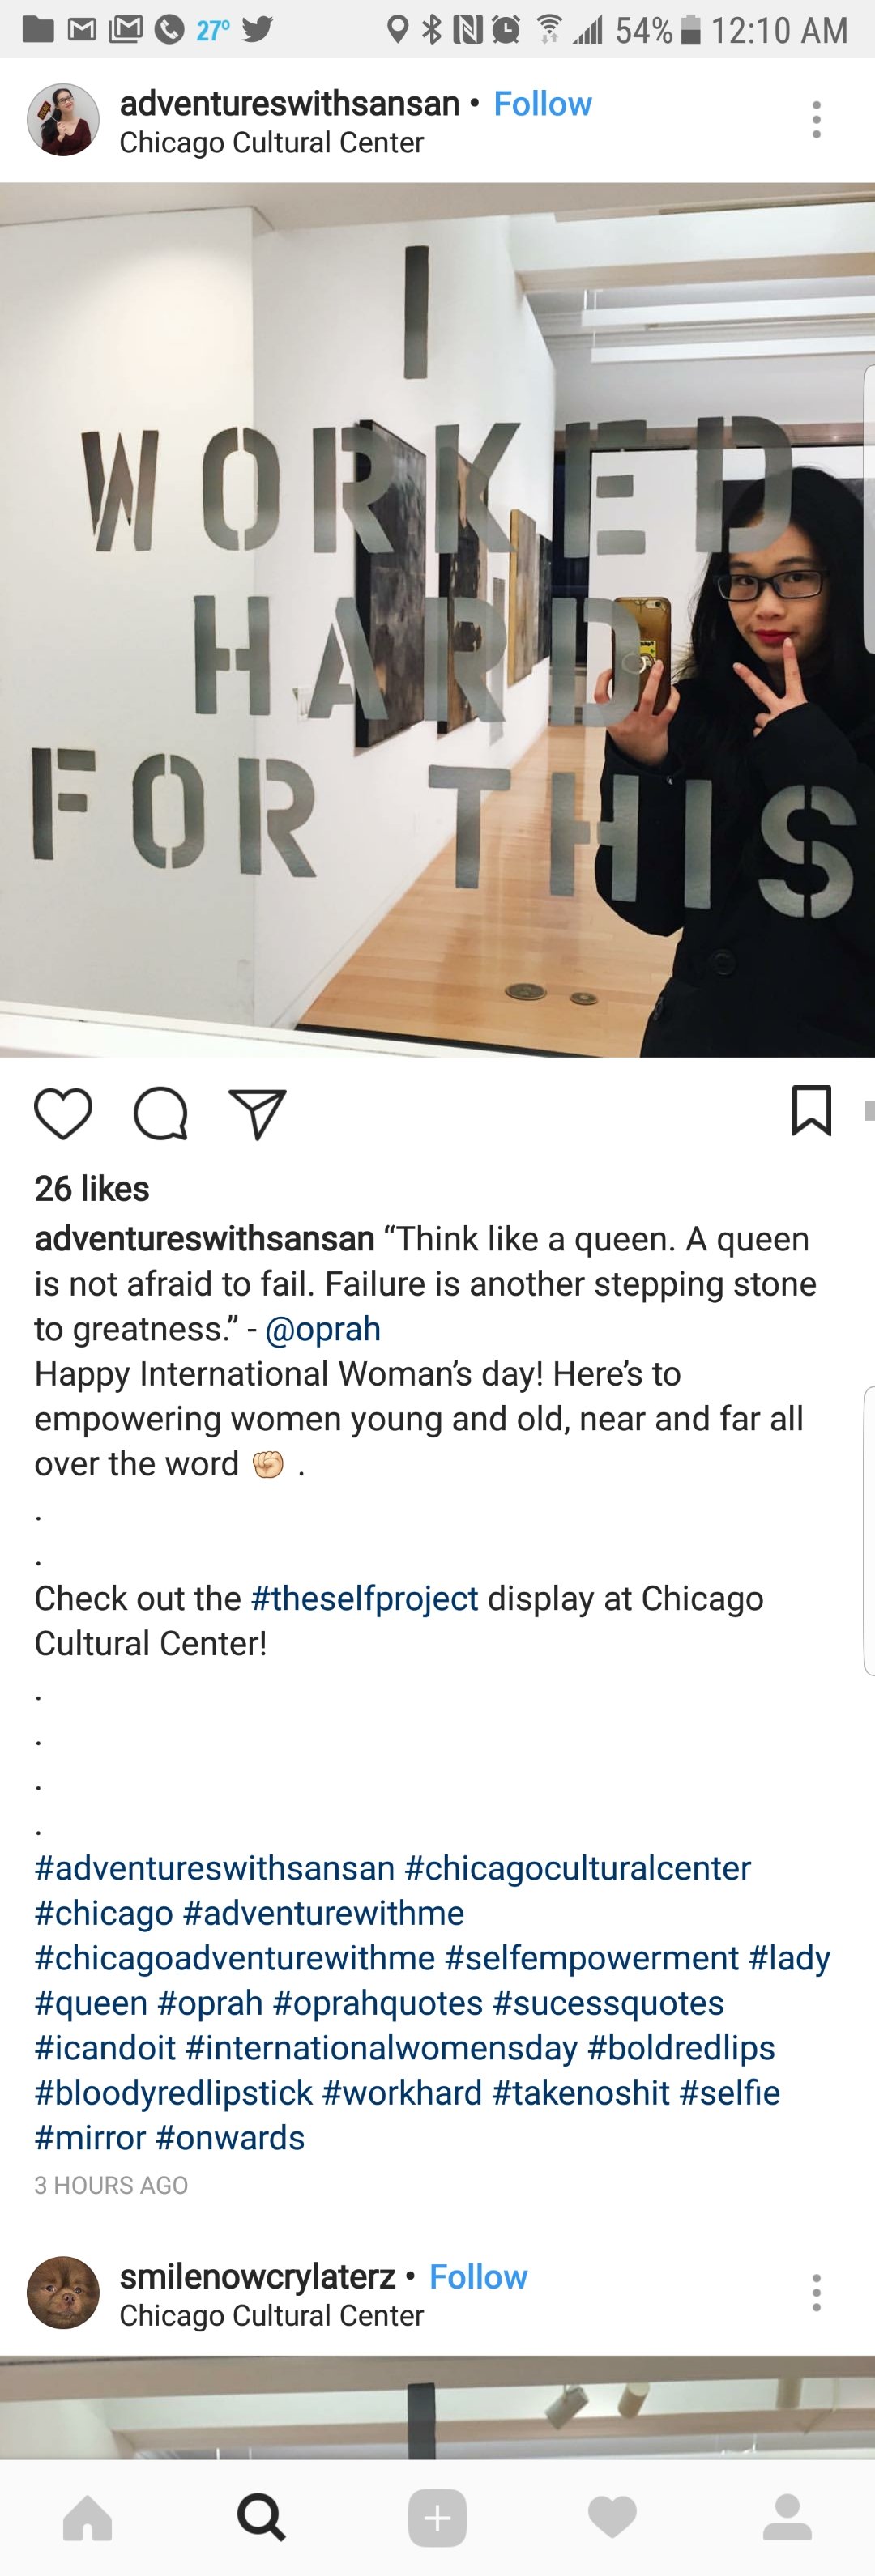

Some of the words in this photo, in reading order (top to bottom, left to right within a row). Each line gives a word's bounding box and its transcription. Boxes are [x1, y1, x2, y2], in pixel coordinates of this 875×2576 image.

[617, 17, 672, 44] 54%
[713, 17, 790, 44] 12:10
[801, 17, 847, 44] AM
[121, 88, 459, 116] adventureswithsansan
[496, 90, 592, 117] Follow
[121, 130, 224, 159] Chicago
[233, 130, 330, 153] Cultural
[340, 131, 425, 153] Center
[403, 245, 429, 380] I
[81, 415, 793, 556] WORKED
[194, 595, 642, 728] HARD
[32, 747, 317, 879] FOR
[428, 764, 857, 918] THIS
[35, 1175, 72, 1202] 26
[83, 1174, 149, 1202] likes
[36, 1224, 373, 1251] adventureswithsansan
[489, 1225, 538, 1251] like
[549, 1232, 565, 1251] a
[575, 1232, 674, 1257] queen.
[686, 1226, 707, 1251] A
[718, 1232, 808, 1257] queen
[36, 1271, 58, 1297] is
[70, 1273, 117, 1297] not
[128, 1269, 211, 1297] afraid
[222, 1273, 250, 1297] to
[261, 1269, 314, 1297] fail.
[327, 1270, 425, 1297] Failure
[437, 1271, 459, 1297] is
[471, 1270, 585, 1297] another
[595, 1271, 723, 1303] stepping
[734, 1273, 816, 1297] stone
[34, 1318, 62, 1341] to
[267, 1314, 380, 1348] @oprah
[36, 1361, 130, 1393] Happy
[142, 1360, 327, 1386] International
[482, 1360, 542, 1393] day!
[652, 1363, 681, 1386] to
[35, 1406, 220, 1437] empowering
[231, 1411, 340, 1431] women
[351, 1411, 442, 1438] young
[453, 1405, 506, 1431] and
[518, 1405, 570, 1435] old,
[581, 1411, 646, 1431] near
[656, 1405, 709, 1431] and
[720, 1404, 761, 1431] far
[771, 1405, 802, 1431] all
[35, 1457, 100, 1476] over
[108, 1450, 155, 1476] the
[165, 1450, 237, 1476] word
[36, 1585, 128, 1611] Check
[137, 1587, 185, 1611] out
[194, 1585, 241, 1611] the
[251, 1584, 478, 1618] #theselfproject
[489, 1585, 595, 1618] display
[605, 1587, 632, 1611] at
[642, 1585, 763, 1617] Chicago
[36, 1629, 148, 1656] Cultural
[161, 1630, 266, 1656] Center!
[35, 1854, 394, 1880] #adventureswithsansan
[405, 1854, 752, 1888] #chicagoculturalcenter
[35, 1899, 173, 1932] #chicago
[183, 1899, 464, 1926] #adventurewithme
[35, 1944, 435, 1978] #chicagoadventurewithme
[445, 1944, 739, 1977] #selfempowerment
[749, 1944, 830, 1978] #lady
[35, 1990, 147, 2022] #queen
[157, 1989, 262, 2022] #oprah
[273, 1989, 483, 2022] #oprahquotes
[493, 1991, 723, 2022] #sucessquotes
[35, 2034, 176, 2060] #icandoit
[186, 2034, 578, 2067] #internationalwomensday
[587, 2034, 775, 2067] #boldredlips
[35, 2079, 314, 2112] #bloodyredlipstick
[322, 2079, 481, 2106] #workhard
[493, 2079, 670, 2106] #takenoshit
[680, 2078, 780, 2106] #selfie
[35, 2124, 147, 2150] #mirror
[156, 2123, 305, 2150] #onwards
[35, 2176, 46, 2194] 3
[55, 2176, 133, 2195] HOURS
[140, 2176, 187, 2195] AGO
[120, 2262, 395, 2296] smilenowcrylaterz
[431, 2263, 528, 2289] Follow
[121, 2304, 224, 2332] Chicago
[233, 2304, 330, 2327] Cultural
[340, 2304, 425, 2327] Center
